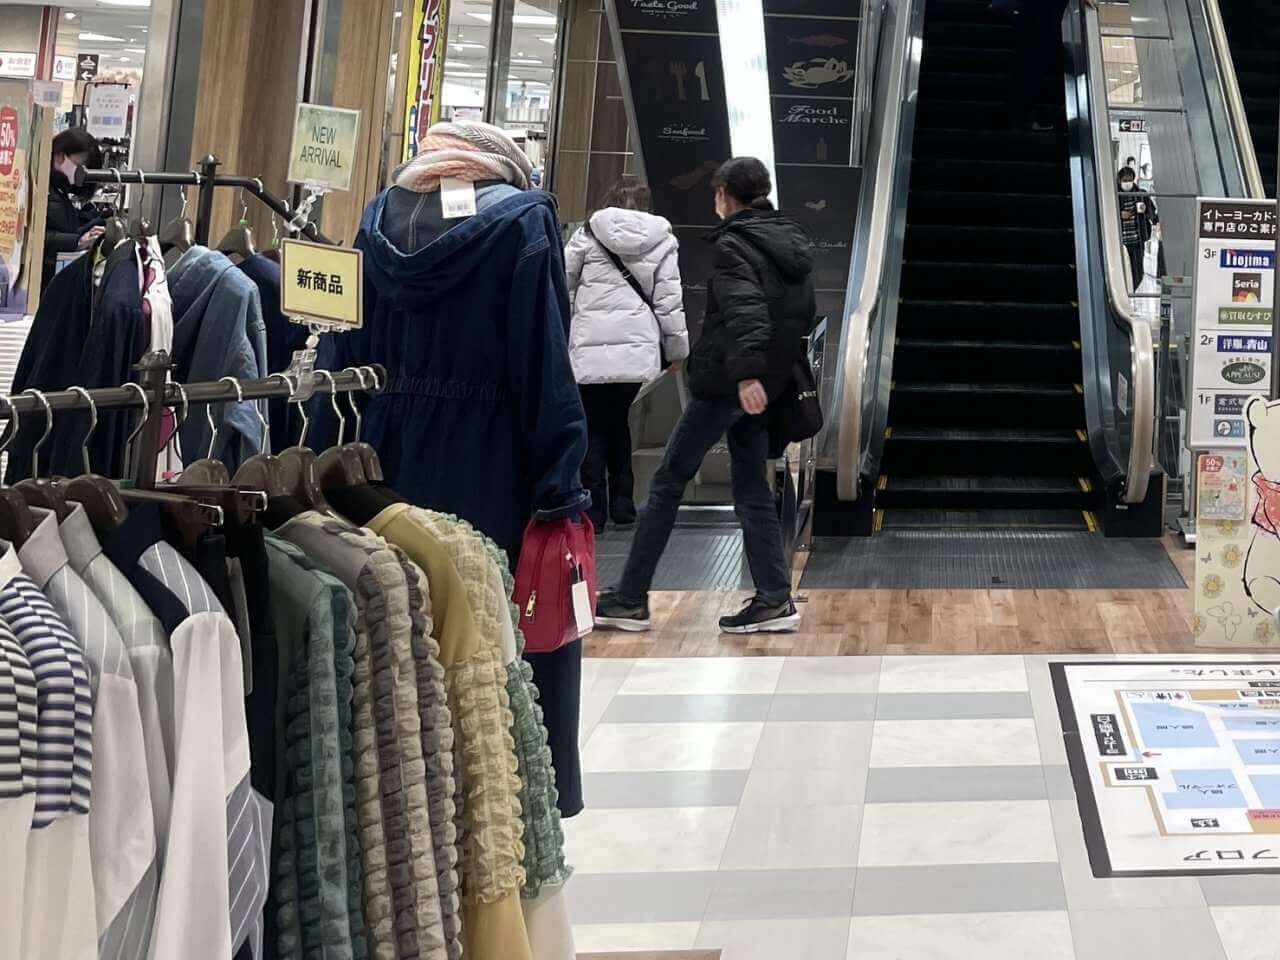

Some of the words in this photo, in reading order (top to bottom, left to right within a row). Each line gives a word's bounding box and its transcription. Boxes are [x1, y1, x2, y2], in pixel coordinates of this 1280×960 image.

[788, 105, 838, 116] Food
[779, 114, 848, 125] Marche
[312, 126, 336, 144] NEW
[300, 146, 342, 168] ARRIVAL
[1204, 248, 1216, 259] 3F
[297, 267, 343, 296] 新商品
[1234, 280, 1259, 289] Seria
[1200, 334, 1214, 346] 2F
[1198, 393, 1211, 405] 1F
